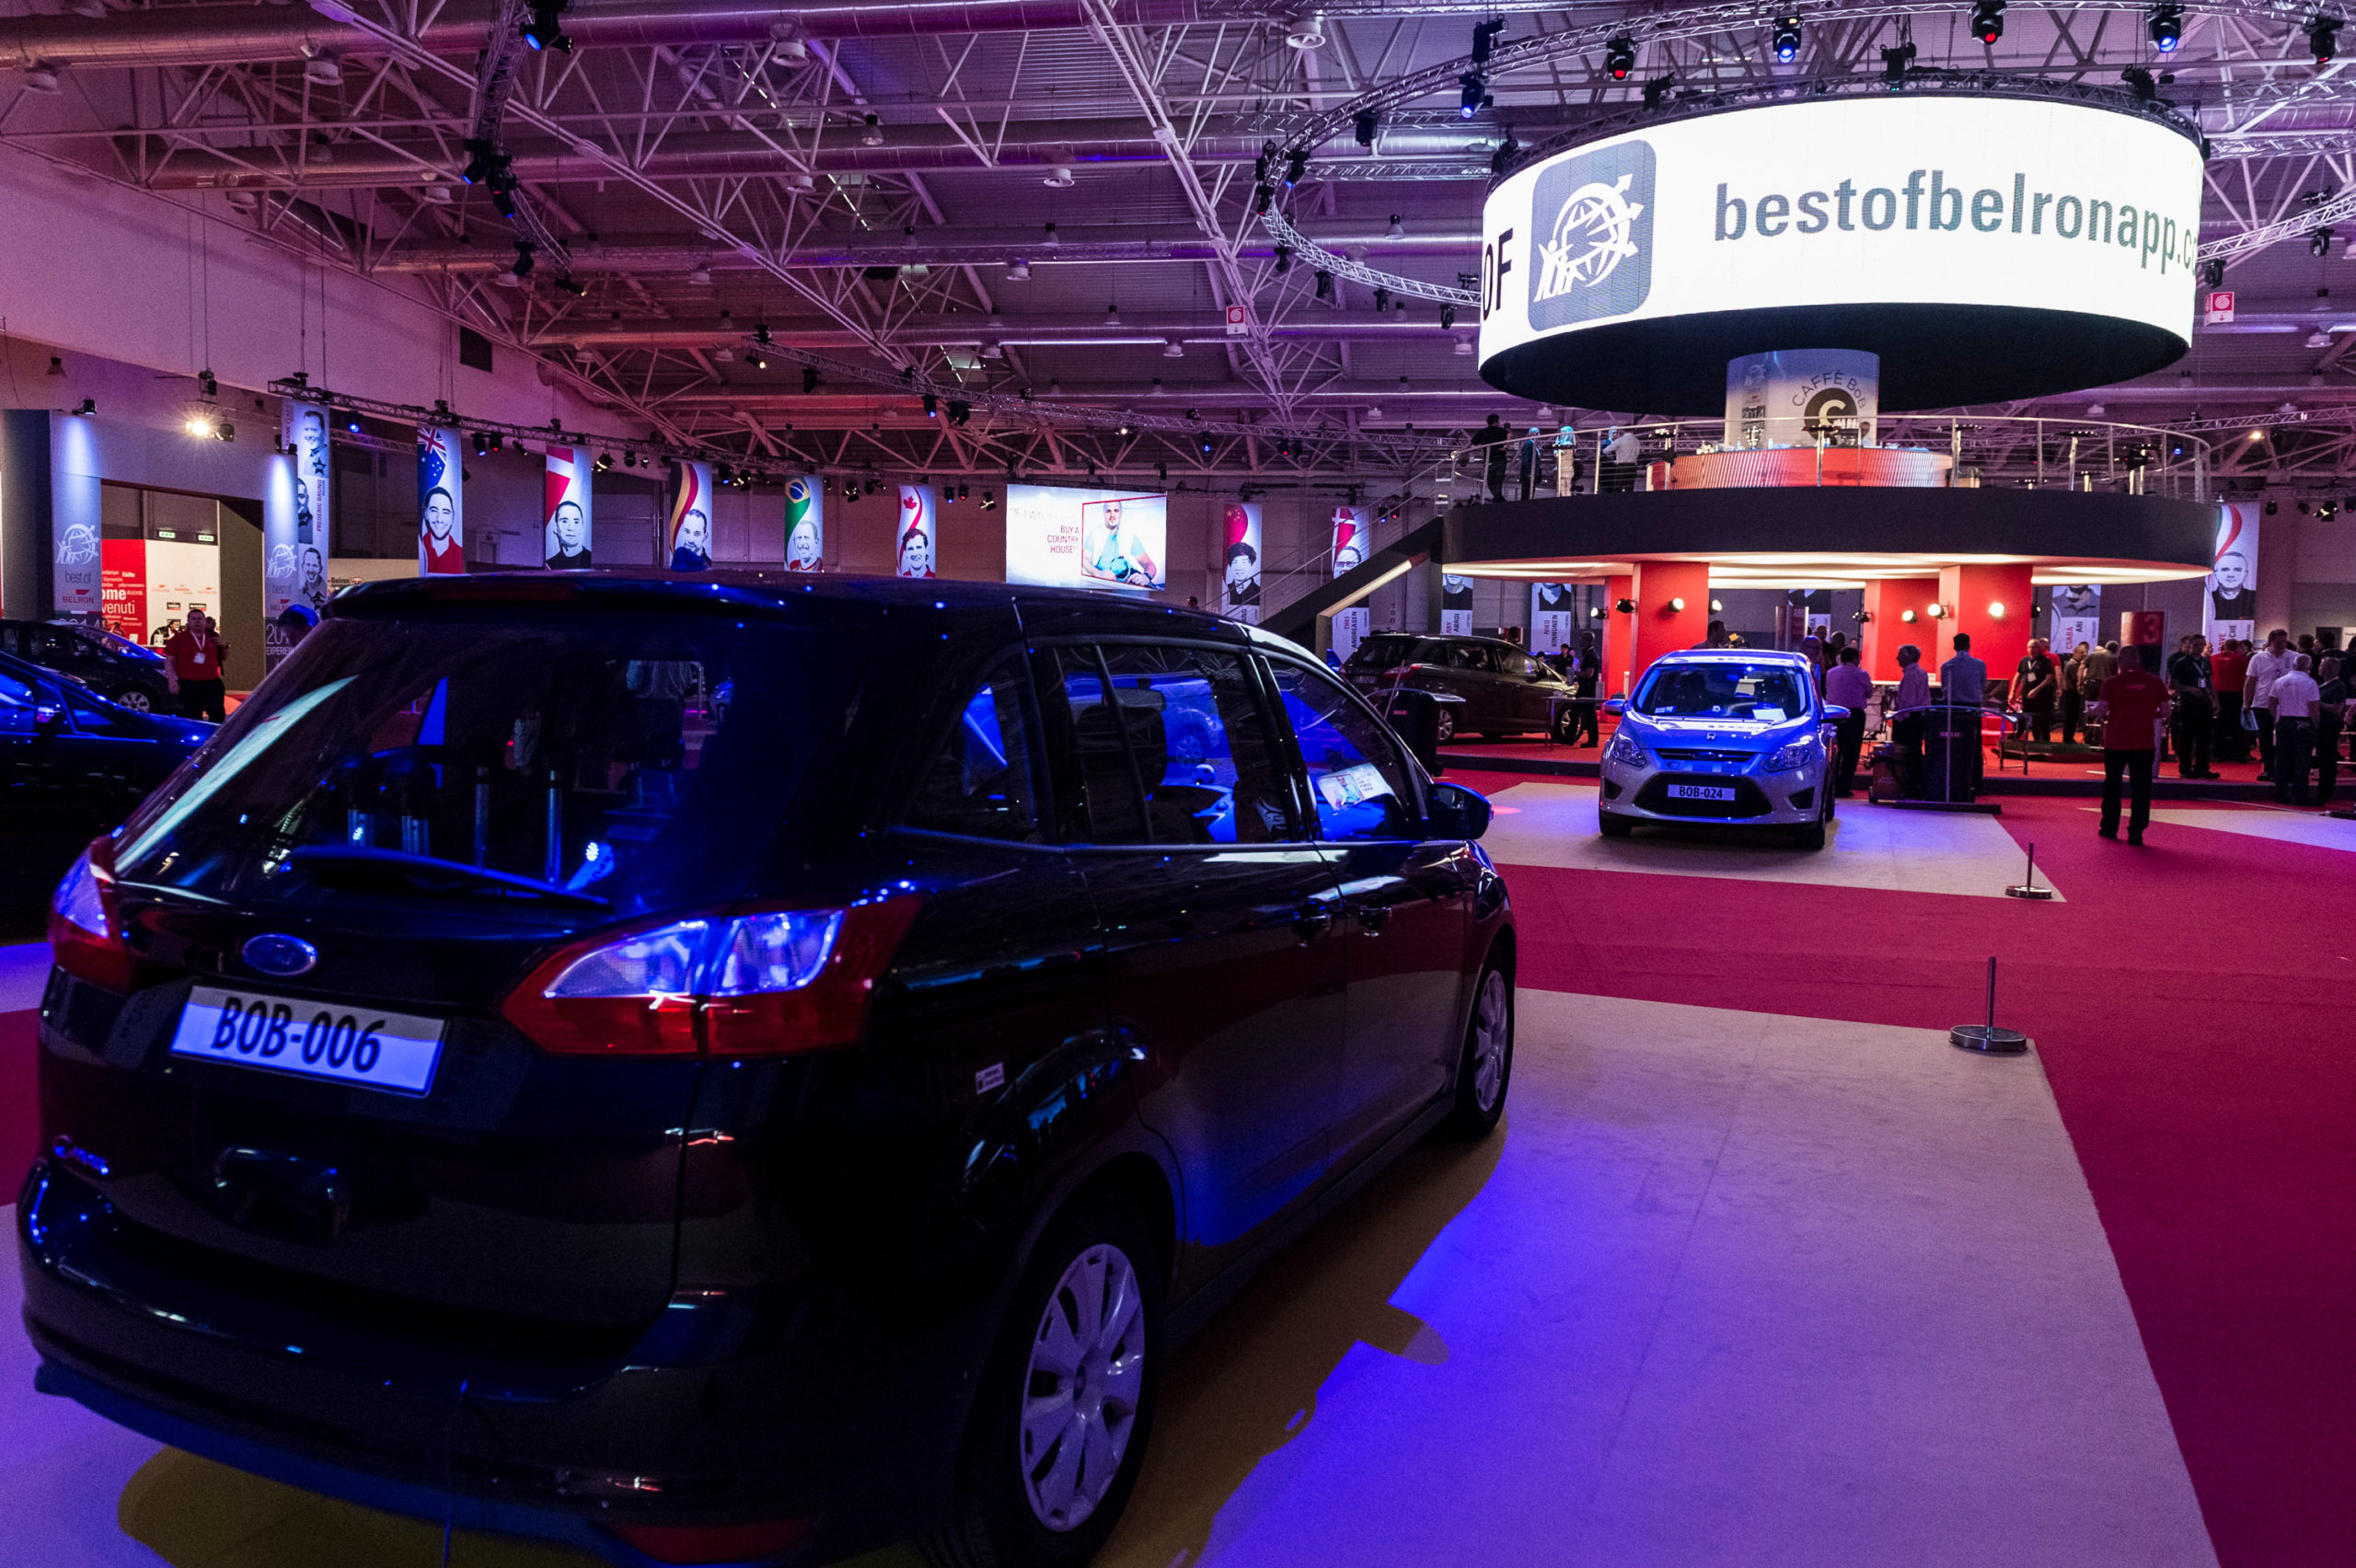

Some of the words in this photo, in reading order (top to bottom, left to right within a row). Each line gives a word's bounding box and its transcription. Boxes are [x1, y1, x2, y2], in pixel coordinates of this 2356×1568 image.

[1483, 227, 1513, 321] OF
[1060, 525, 1073, 534] BUY
[1047, 535, 1079, 544] COUNTRY
[63, 595, 94, 604] BELRON
[2142, 613, 2161, 644] 3
[1680, 786, 1723, 799] BOB-024
[211, 997, 386, 1073] BOB-006
